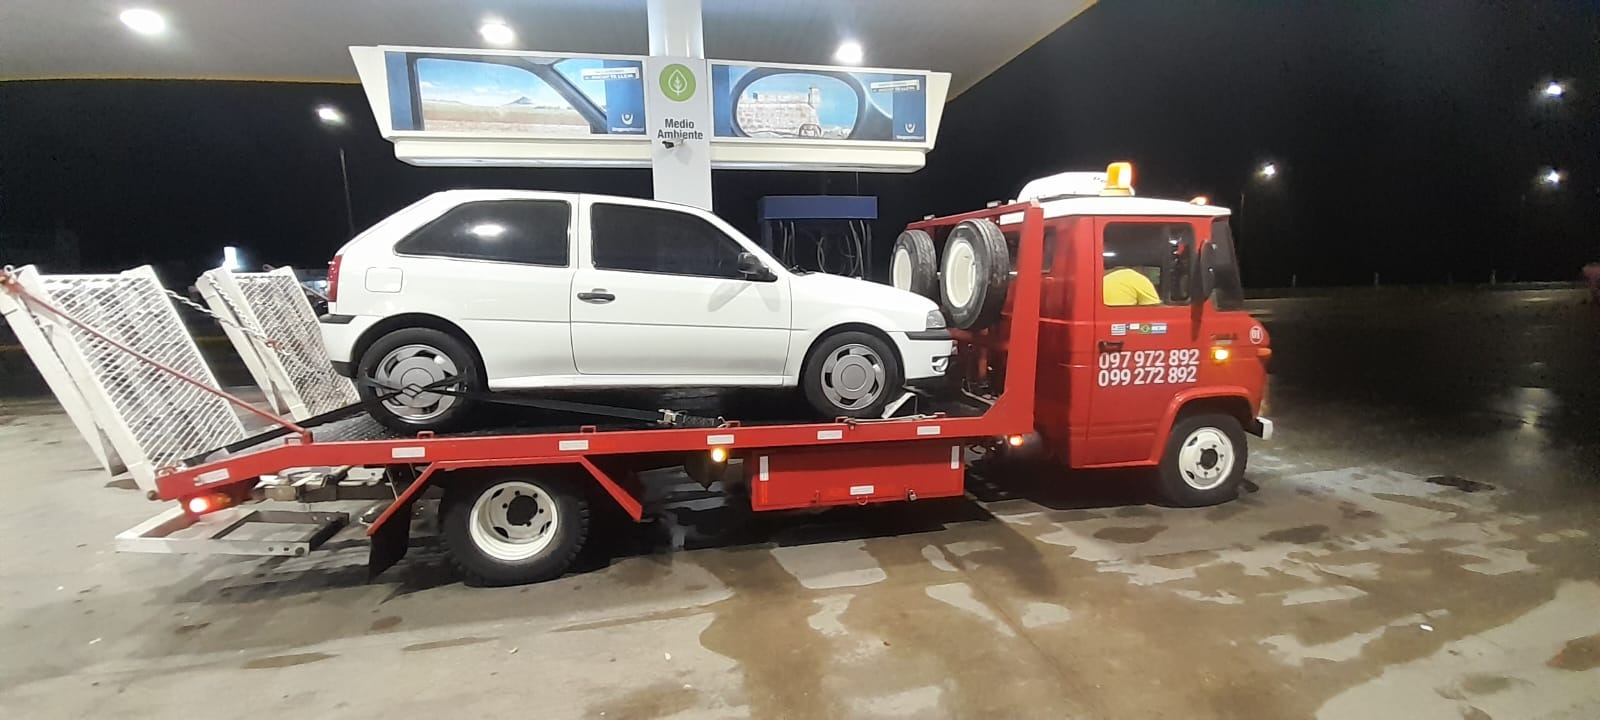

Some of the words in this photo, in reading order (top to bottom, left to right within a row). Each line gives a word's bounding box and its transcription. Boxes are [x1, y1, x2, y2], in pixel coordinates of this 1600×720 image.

[664, 118, 695, 129] Medio
[657, 129, 704, 140] Ambiente
[1098, 351, 1132, 369] 097
[1134, 350, 1166, 367] 972
[1168, 349, 1200, 366] 892
[1098, 369, 1131, 387] 099
[1133, 367, 1165, 385] 272
[1167, 366, 1198, 384] 892
